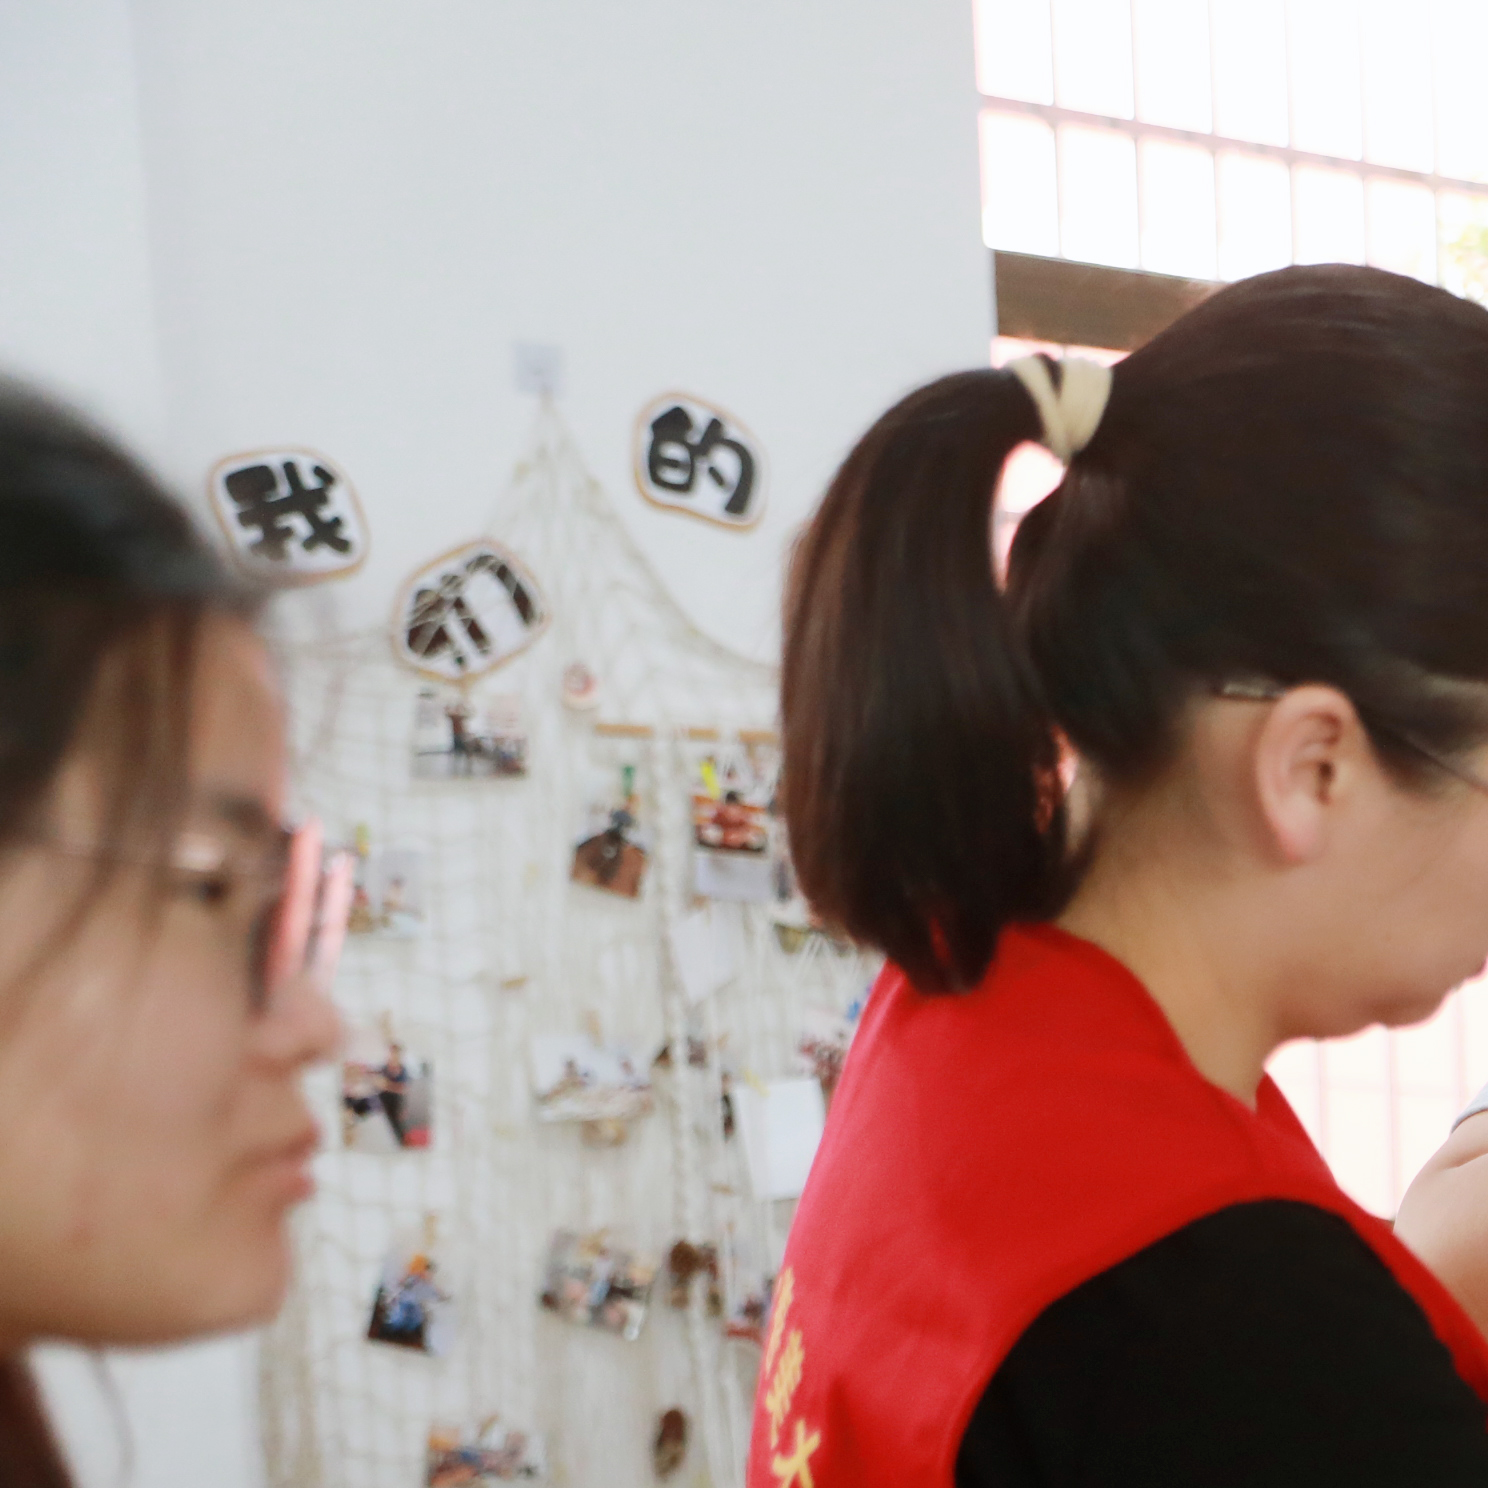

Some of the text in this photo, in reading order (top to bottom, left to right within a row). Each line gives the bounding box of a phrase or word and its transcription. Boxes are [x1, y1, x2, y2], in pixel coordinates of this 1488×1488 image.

[224, 405, 757, 668] 我 们 的
